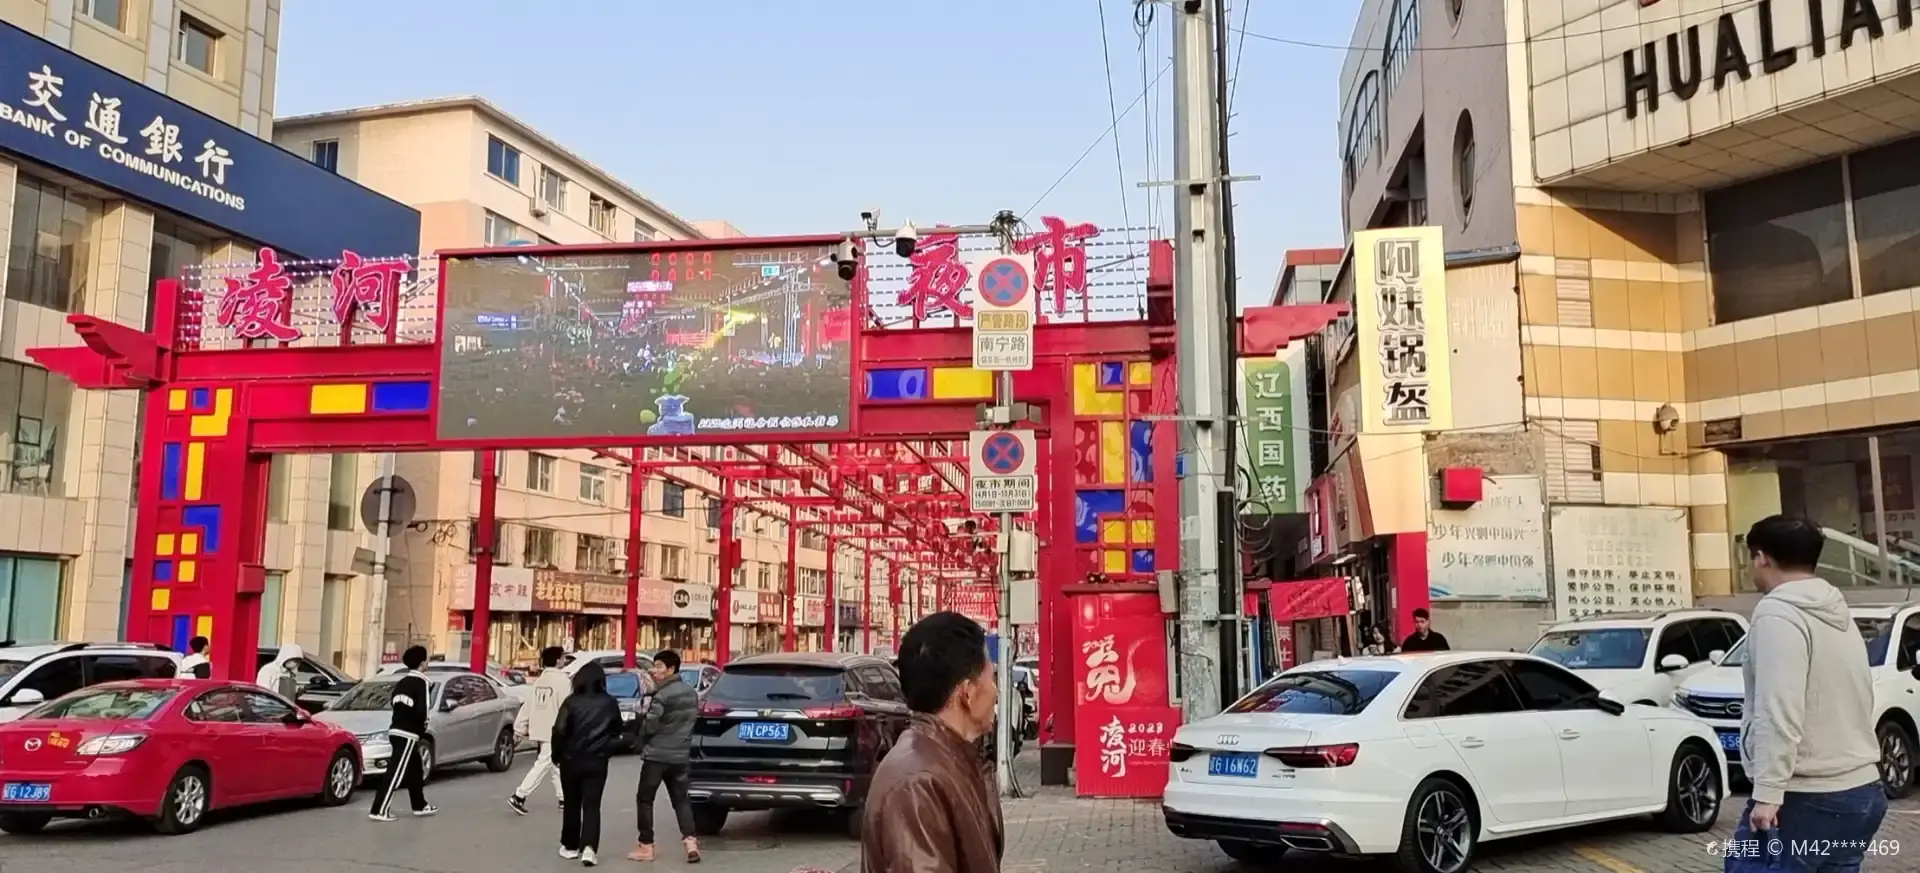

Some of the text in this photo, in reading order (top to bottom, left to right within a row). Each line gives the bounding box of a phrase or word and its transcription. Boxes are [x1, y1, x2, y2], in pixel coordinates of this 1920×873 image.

[22, 65, 234, 185] 交通銀行
[1, 104, 245, 211] BANK OF COMMUNICATIONS
[979, 335, 1025, 352] 南宁路
[1255, 371, 1287, 503] 辽西国药
[975, 479, 1030, 489] 夜市期间
[1127, 722, 1163, 734] 2023
